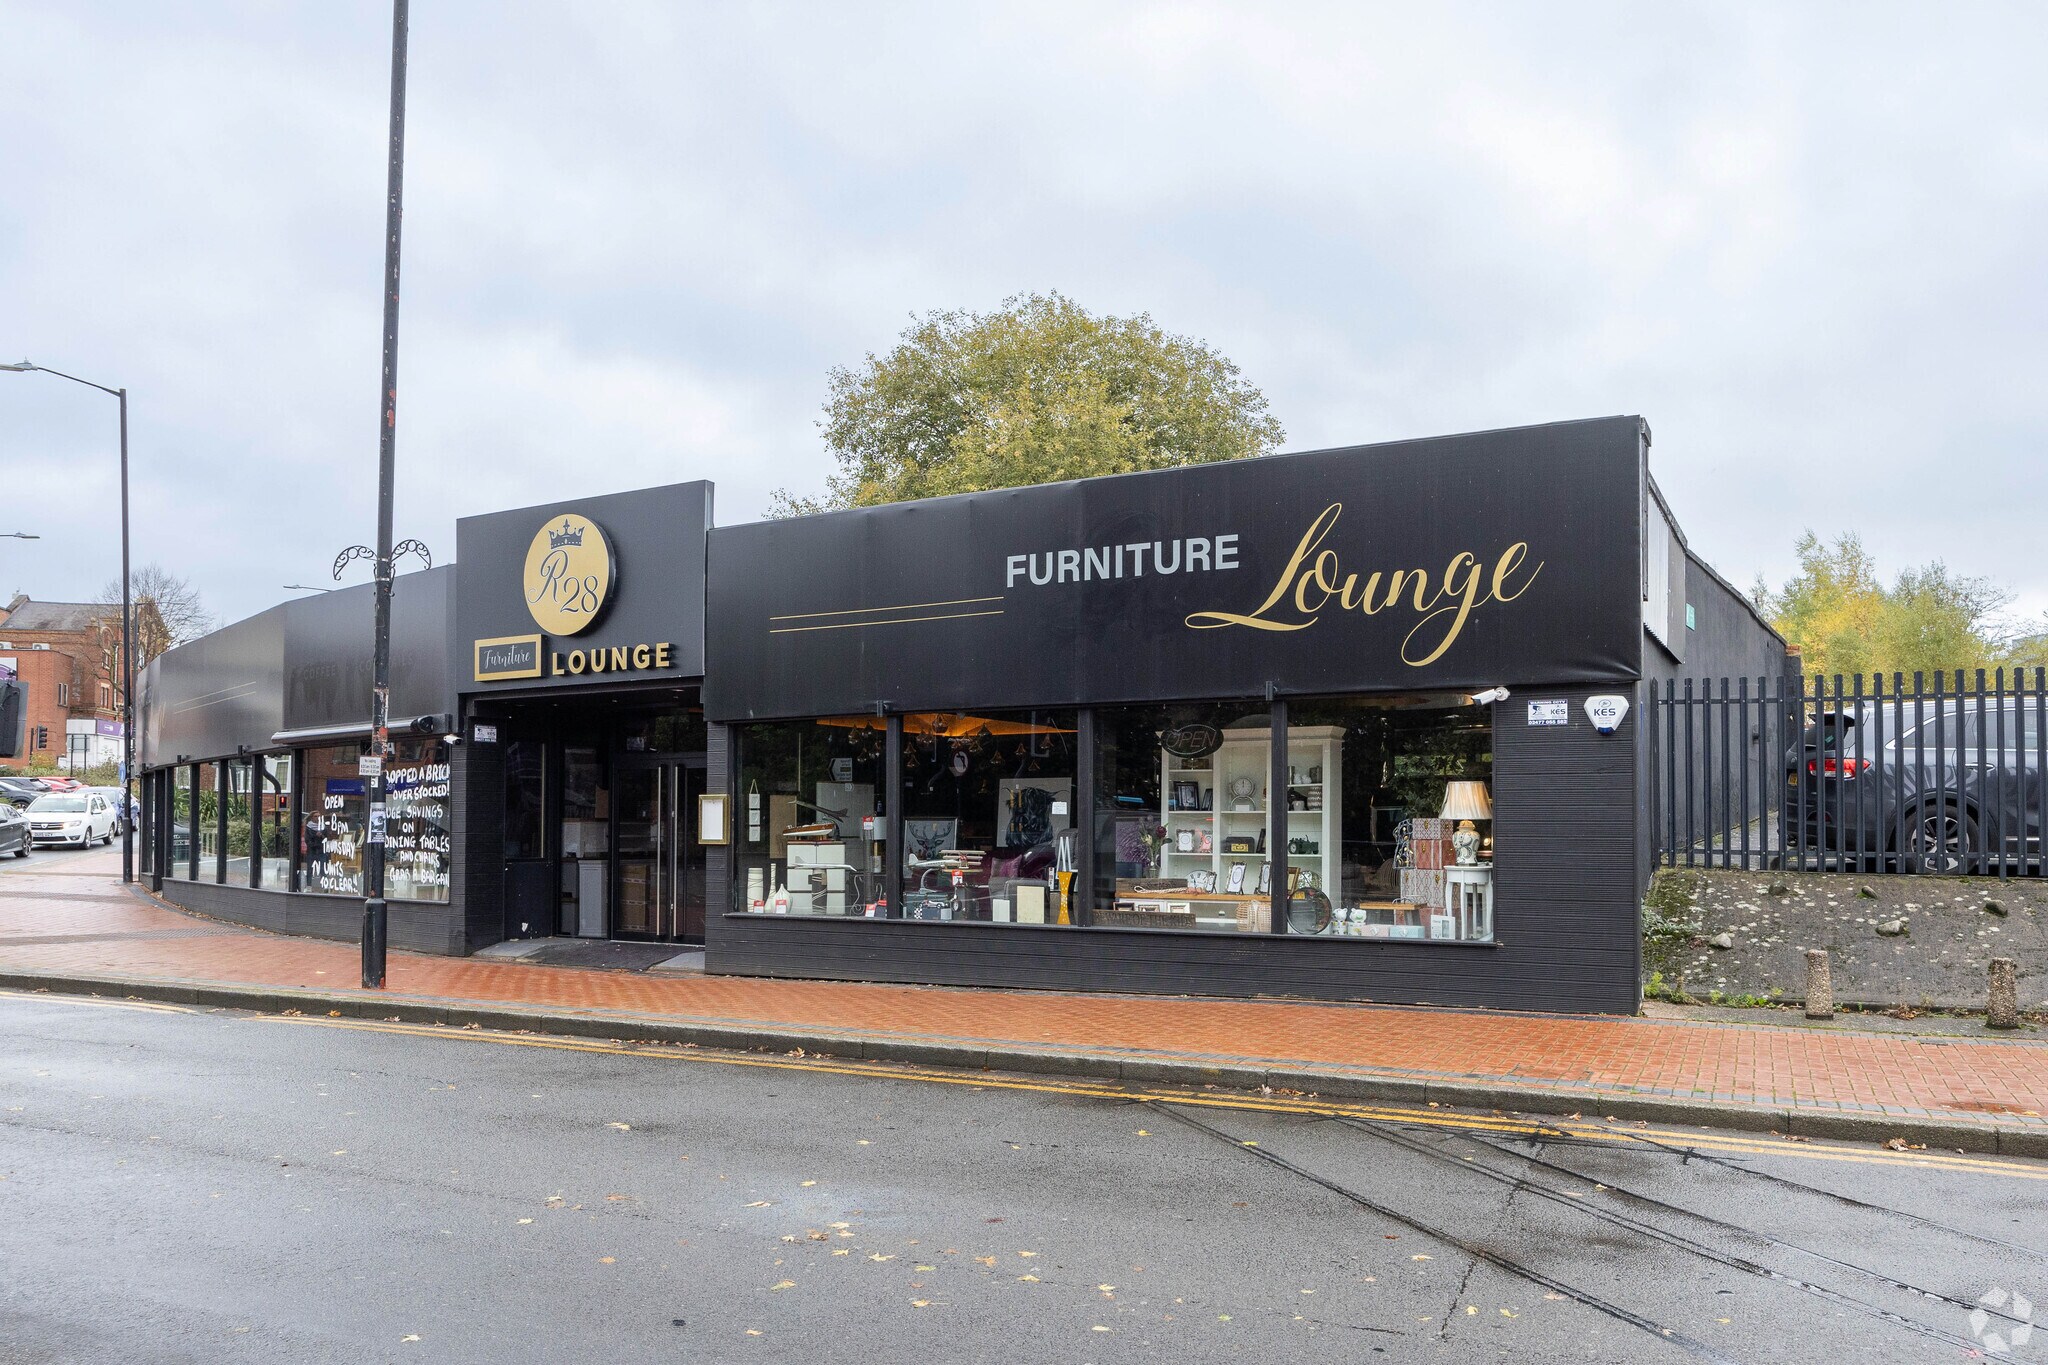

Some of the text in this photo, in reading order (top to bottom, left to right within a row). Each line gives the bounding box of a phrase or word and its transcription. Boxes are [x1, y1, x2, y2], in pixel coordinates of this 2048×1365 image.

[527, 550, 599, 613] R28
[1006, 502, 1544, 667] FURNITURE Lounge
[484, 642, 670, 676] Furniture LOUNGE
[1593, 708, 1616, 716] KES
[1166, 730, 1217, 748] OPEN
[385, 768, 417, 784] ROPPED
[418, 766, 426, 780] A
[324, 795, 344, 810] OPEN
[386, 804, 443, 819] UGE SAVINGS
[402, 821, 414, 833] ON
[322, 838, 355, 860] THURSDAY
[385, 835, 416, 849] DINING
[419, 834, 450, 853] TABLES
[400, 850, 413, 863] AND
[323, 860, 344, 878] UNITS
[389, 866, 410, 882] GRAB
